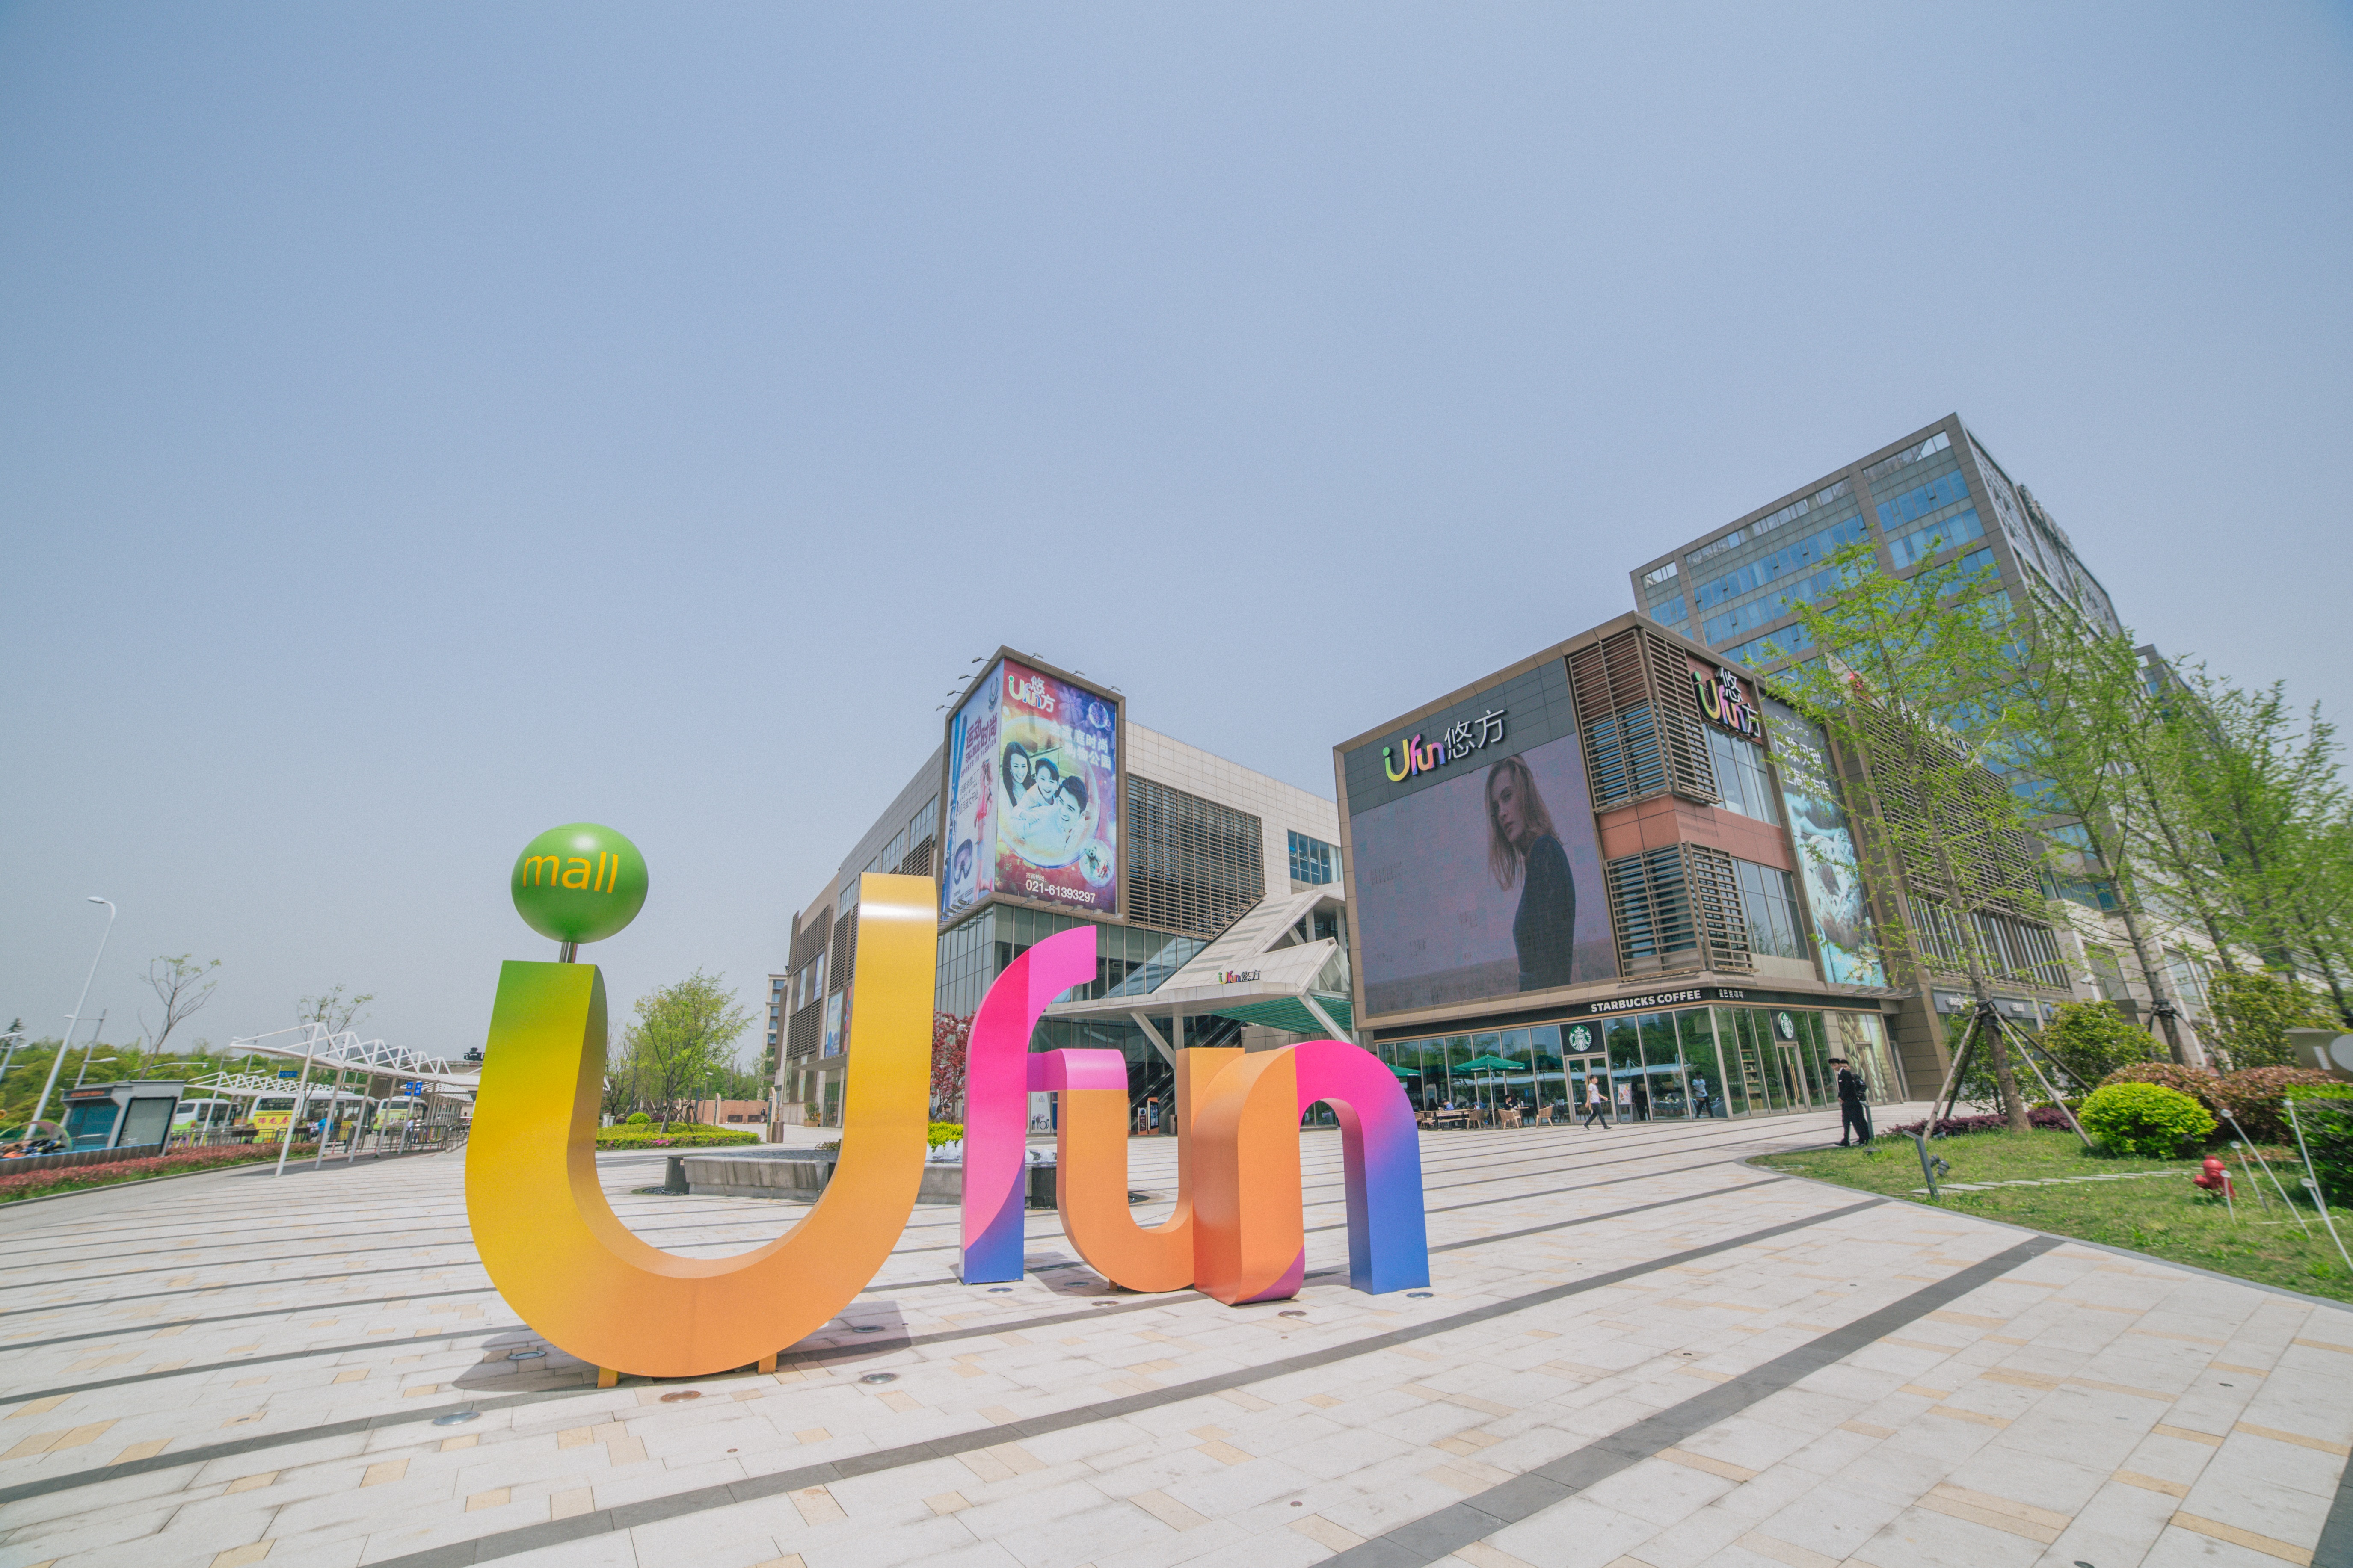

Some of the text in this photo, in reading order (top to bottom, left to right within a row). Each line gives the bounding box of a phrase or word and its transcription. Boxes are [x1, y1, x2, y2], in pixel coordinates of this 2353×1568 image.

[1031, 676, 1055, 713] 悠方
[1716, 667, 1760, 737] 悠方
[966, 713, 997, 751] 运动时尚
[1444, 709, 1506, 760] 悠方
[961, 737, 996, 778] SPORTS IN FASHION
[1064, 741, 1111, 770] 购物公园
[523, 851, 618, 893] mall
[1026, 879, 1096, 903] 021-61393297
[1241, 970, 1261, 982] 悠方
[1719, 989, 1744, 999] 星巴克咖啡
[1591, 990, 1701, 1012] STARBUCKS COFFEE
